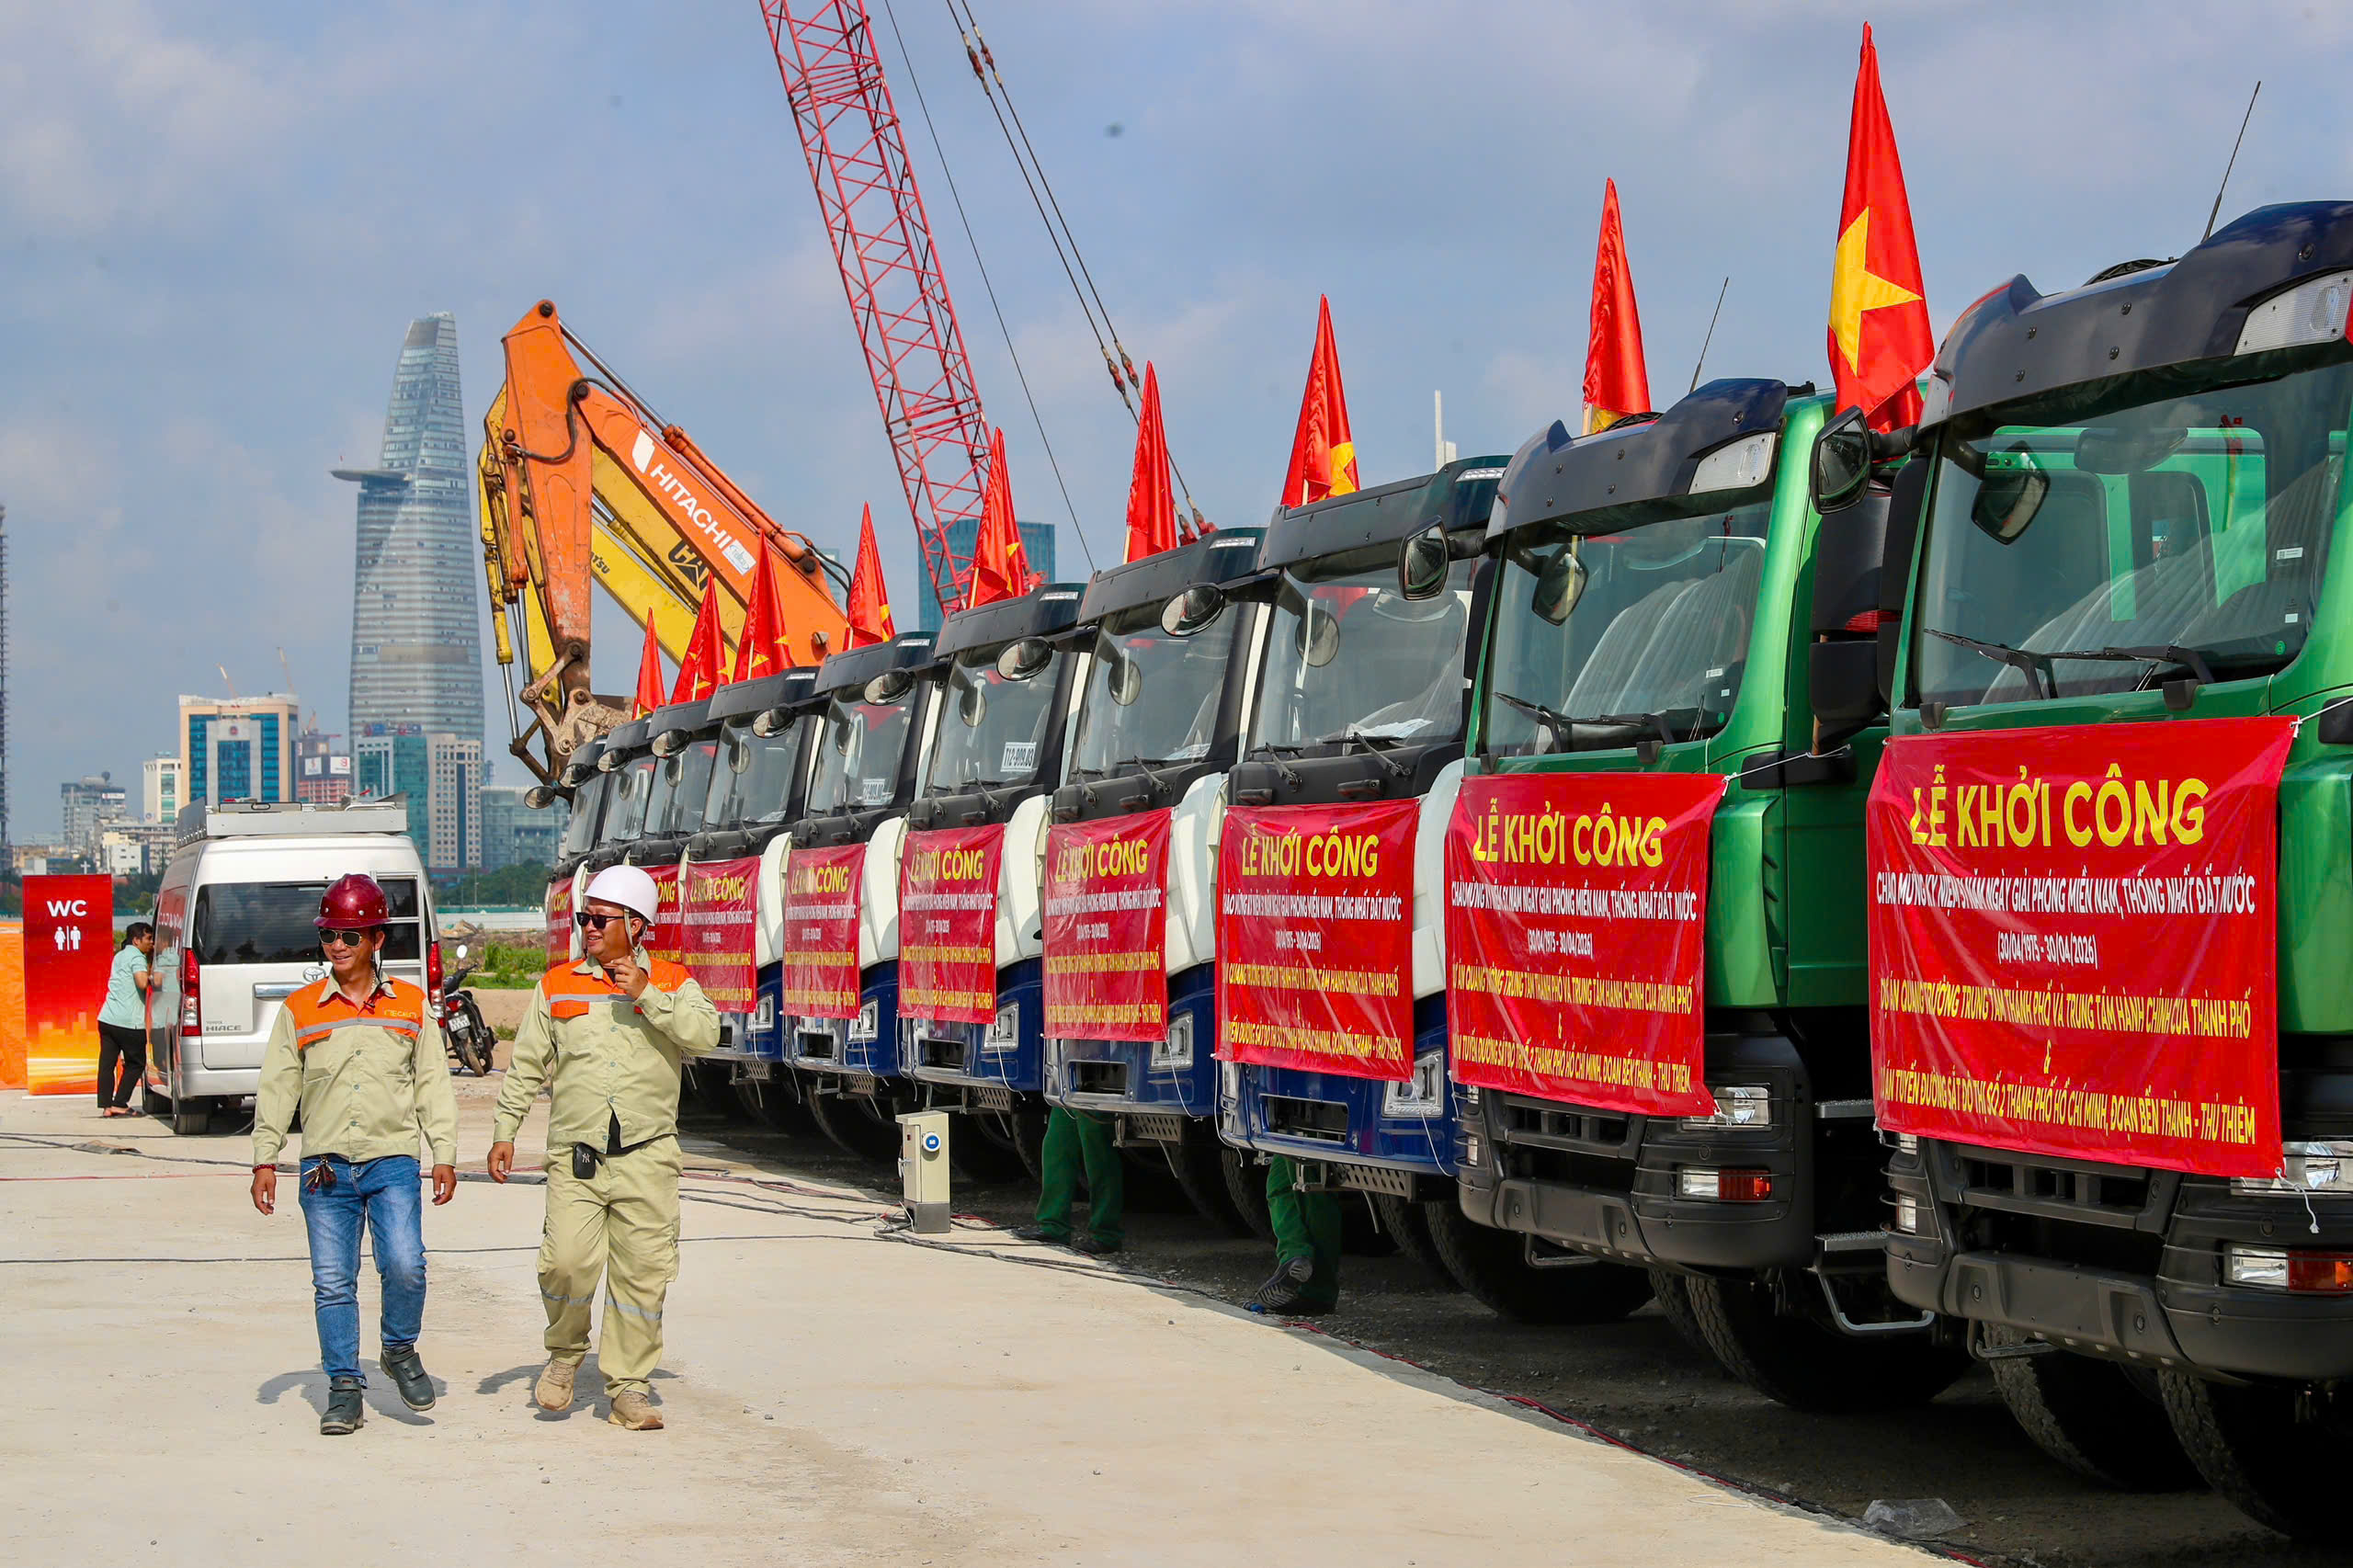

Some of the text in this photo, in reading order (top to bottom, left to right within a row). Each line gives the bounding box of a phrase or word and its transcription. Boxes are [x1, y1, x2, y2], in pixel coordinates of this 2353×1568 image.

[650, 463, 733, 550] HITACHI
[1909, 763, 2209, 847] LỄ KHỞI CÔNG
[1097, 833, 1148, 877] CÔNG
[1306, 824, 1379, 877] CÔNG
[1472, 798, 1667, 868] LỄ KHỞI CÔNG
[816, 859, 849, 893] CÔNG
[942, 842, 984, 881] CÔNG
[46, 899, 87, 917] WC
[656, 876, 676, 903] ÔNG
[714, 871, 745, 901] CÔNG
[1610, 880, 1637, 918] THỐNG
[1638, 881, 1657, 919] NHẤT
[1985, 869, 2012, 912] NGÀY
[2031, 869, 2066, 913] PHÓNG
[2068, 865, 2094, 914] MIỀN
[2094, 878, 2124, 919] NAM,
[2122, 865, 2165, 914] THỐNG
[2165, 863, 2194, 914] NHẤT
[2196, 863, 2222, 914] ĐẤT
[2220, 866, 2256, 914] NƯỚC
[1677, 975, 1693, 1015] PHỐ
[1961, 984, 1989, 1020] TRUNG
[2033, 979, 2051, 1026] PHỐ
[2052, 983, 2064, 1028] VÀ
[2066, 994, 2095, 1029] TRUNG
[2116, 986, 2144, 1032] HÀNH
[2191, 989, 2228, 1037] THÀNH
[2230, 986, 2251, 1039] PHỐ
[2035, 1076, 2057, 1123] PHỐ
[2068, 1083, 2086, 1127] CHÍ
[2110, 1096, 2138, 1142] ĐOẠN
[2139, 1085, 2159, 1134] BẾN
[2161, 1090, 2192, 1139] THÀNH
[2221, 1096, 2256, 1144] THIÊM
